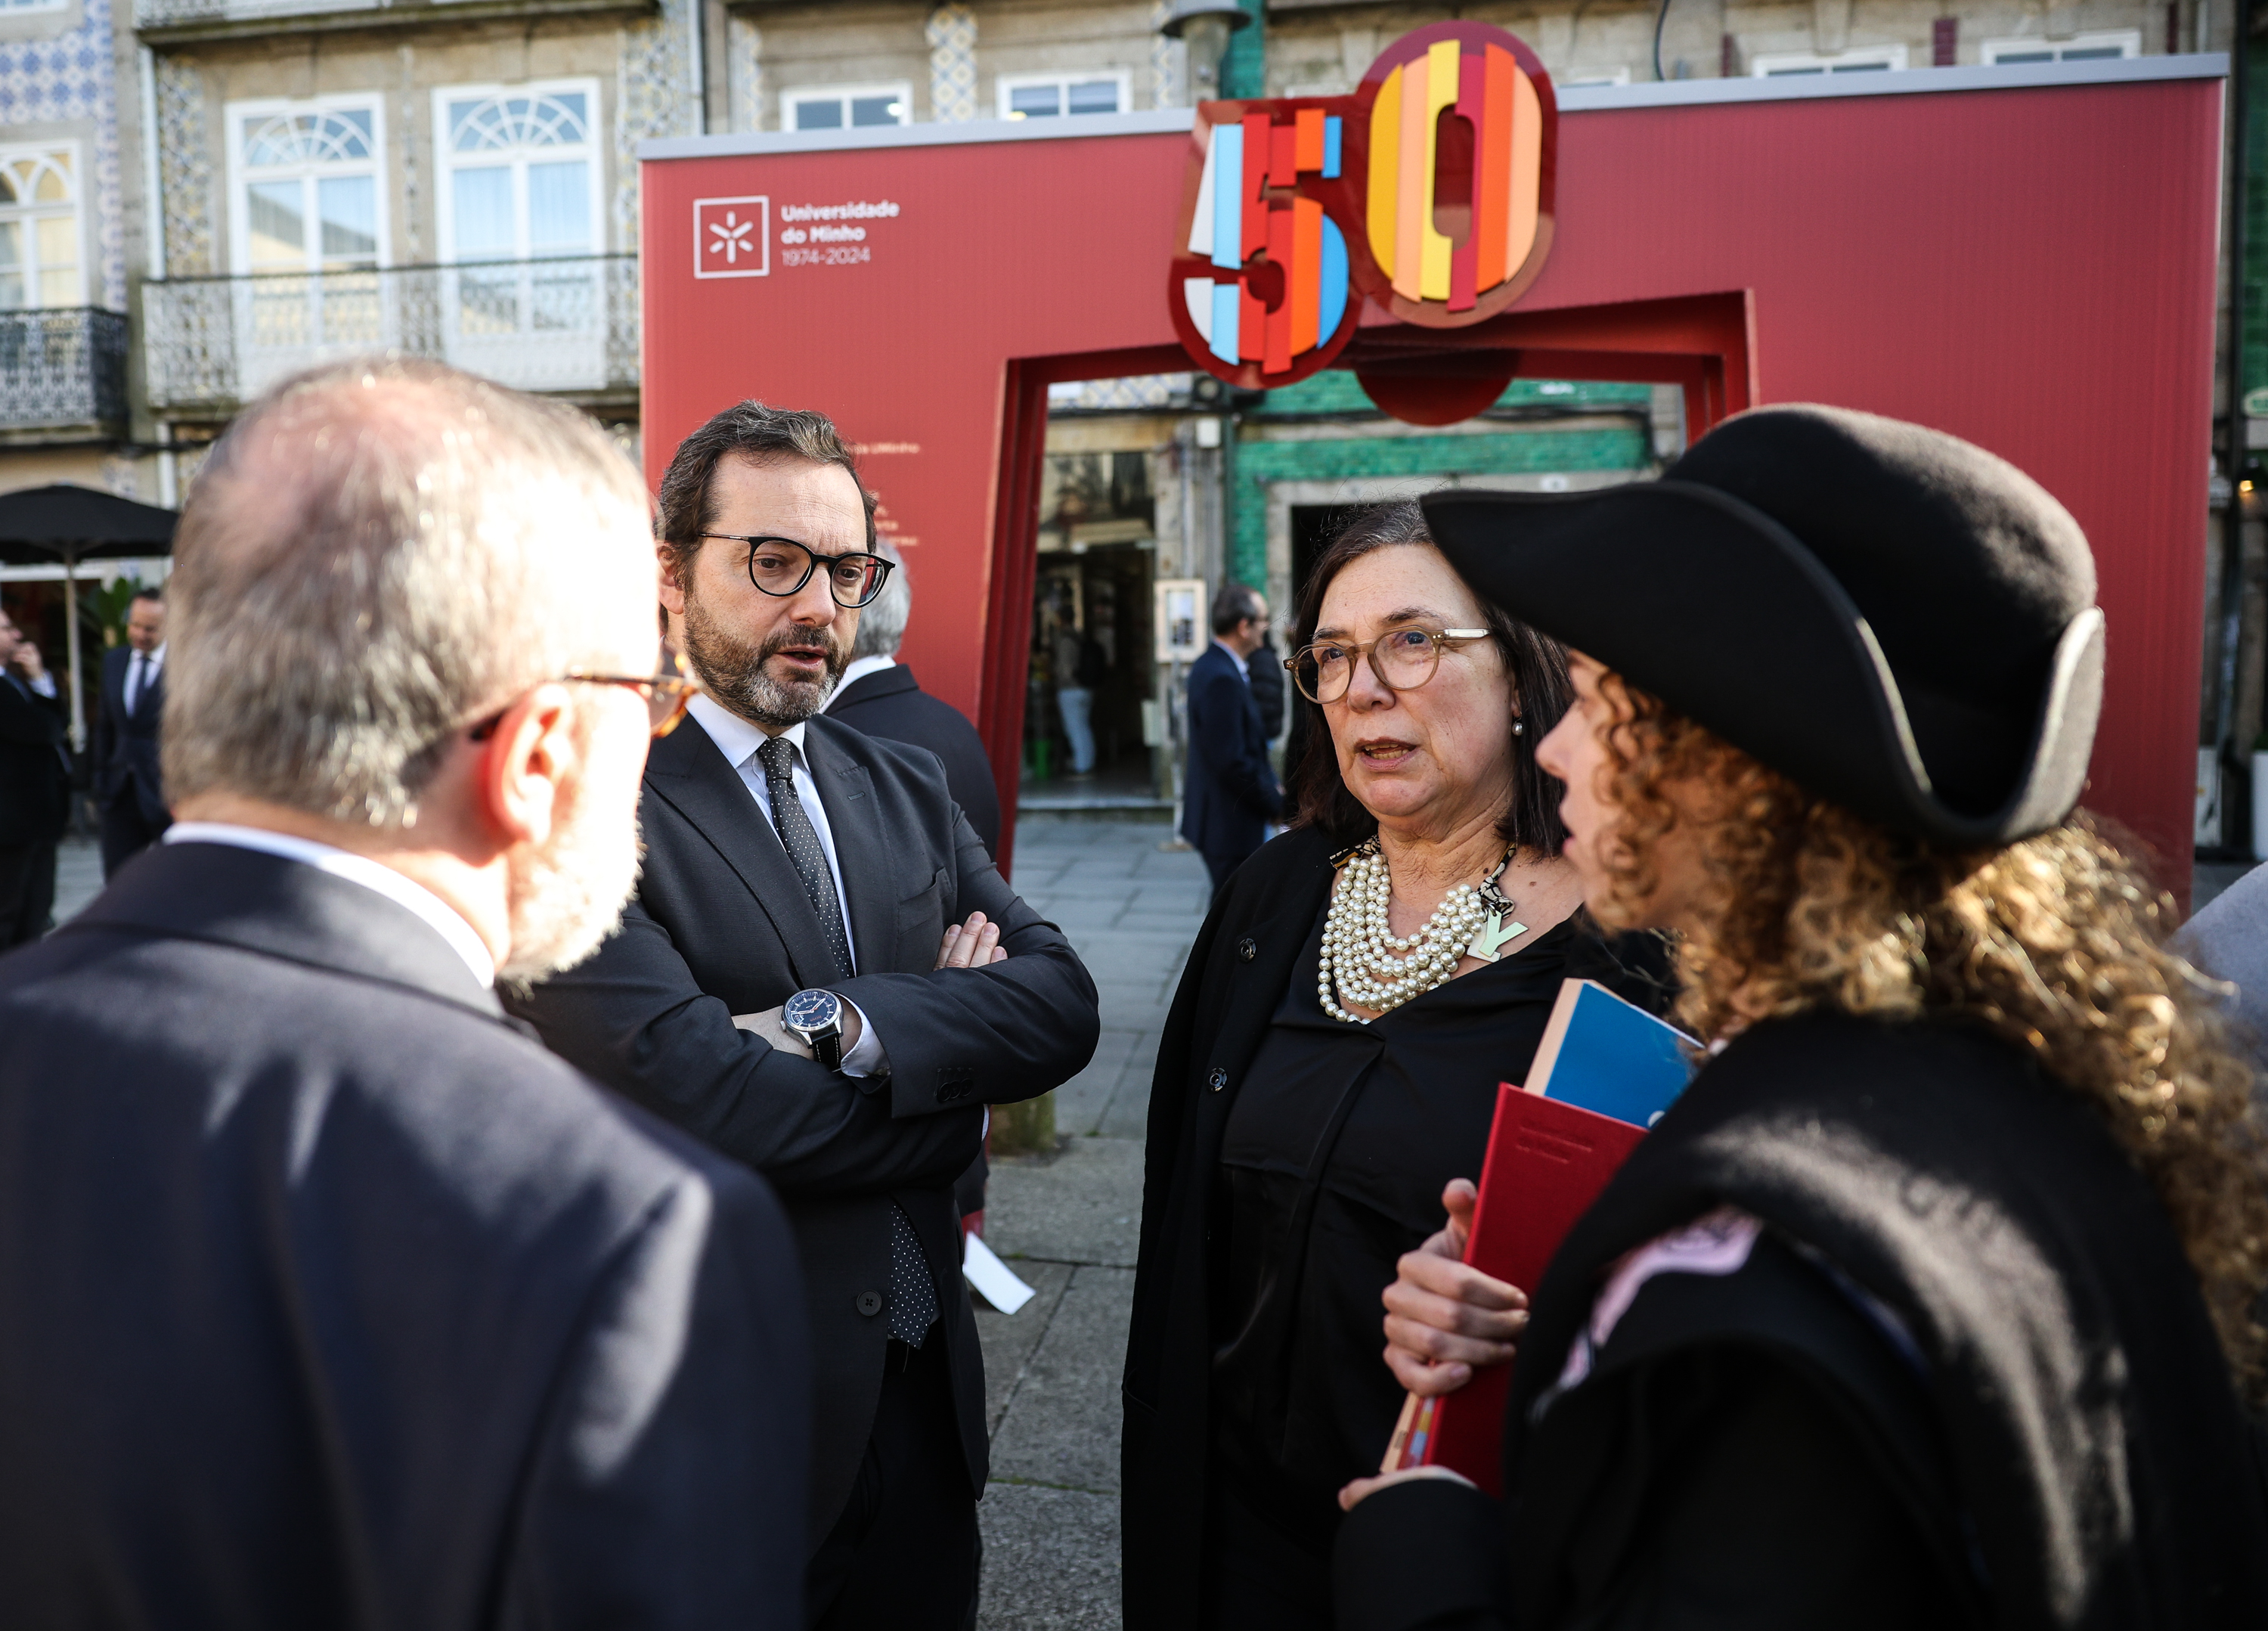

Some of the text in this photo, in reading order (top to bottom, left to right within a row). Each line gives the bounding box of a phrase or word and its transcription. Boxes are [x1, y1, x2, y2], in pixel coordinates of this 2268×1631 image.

[781, 200, 900, 222] Universidade
[1184, 39, 1542, 374] 50
[781, 224, 866, 244] do Minho
[781, 247, 871, 266] 1974-2024
